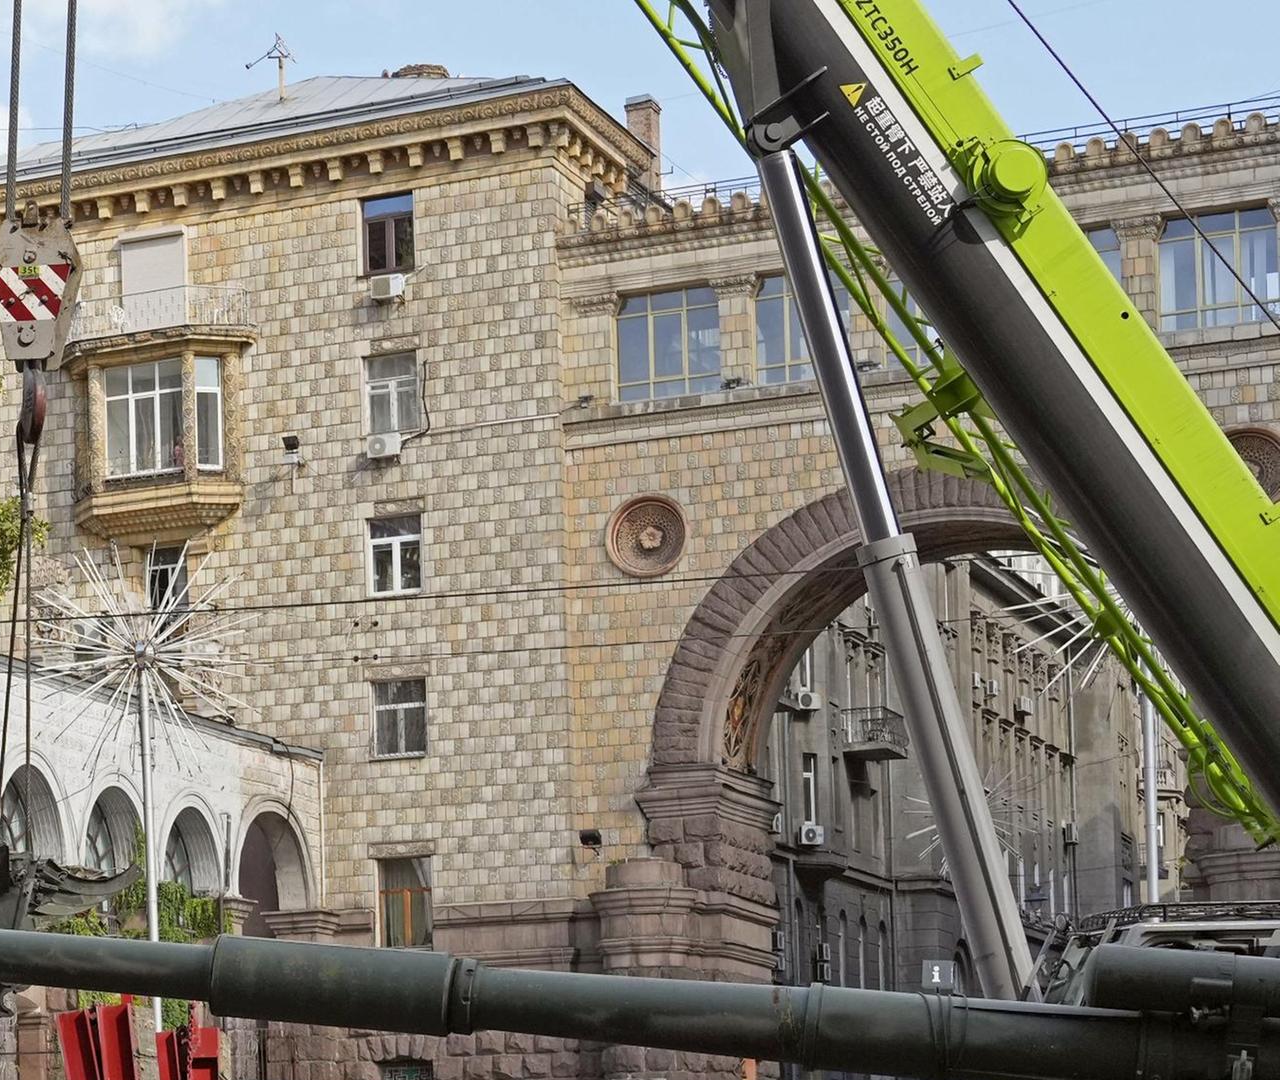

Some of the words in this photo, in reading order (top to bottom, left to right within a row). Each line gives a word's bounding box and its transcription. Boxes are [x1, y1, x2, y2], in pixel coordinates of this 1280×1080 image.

[854, 107, 866, 123] НЕ
[866, 122, 888, 154] СТОЙ
[886, 151, 904, 179] ПОД
[903, 176, 943, 227] СТРЕЛОЙ
[931, 965, 941, 983] i
